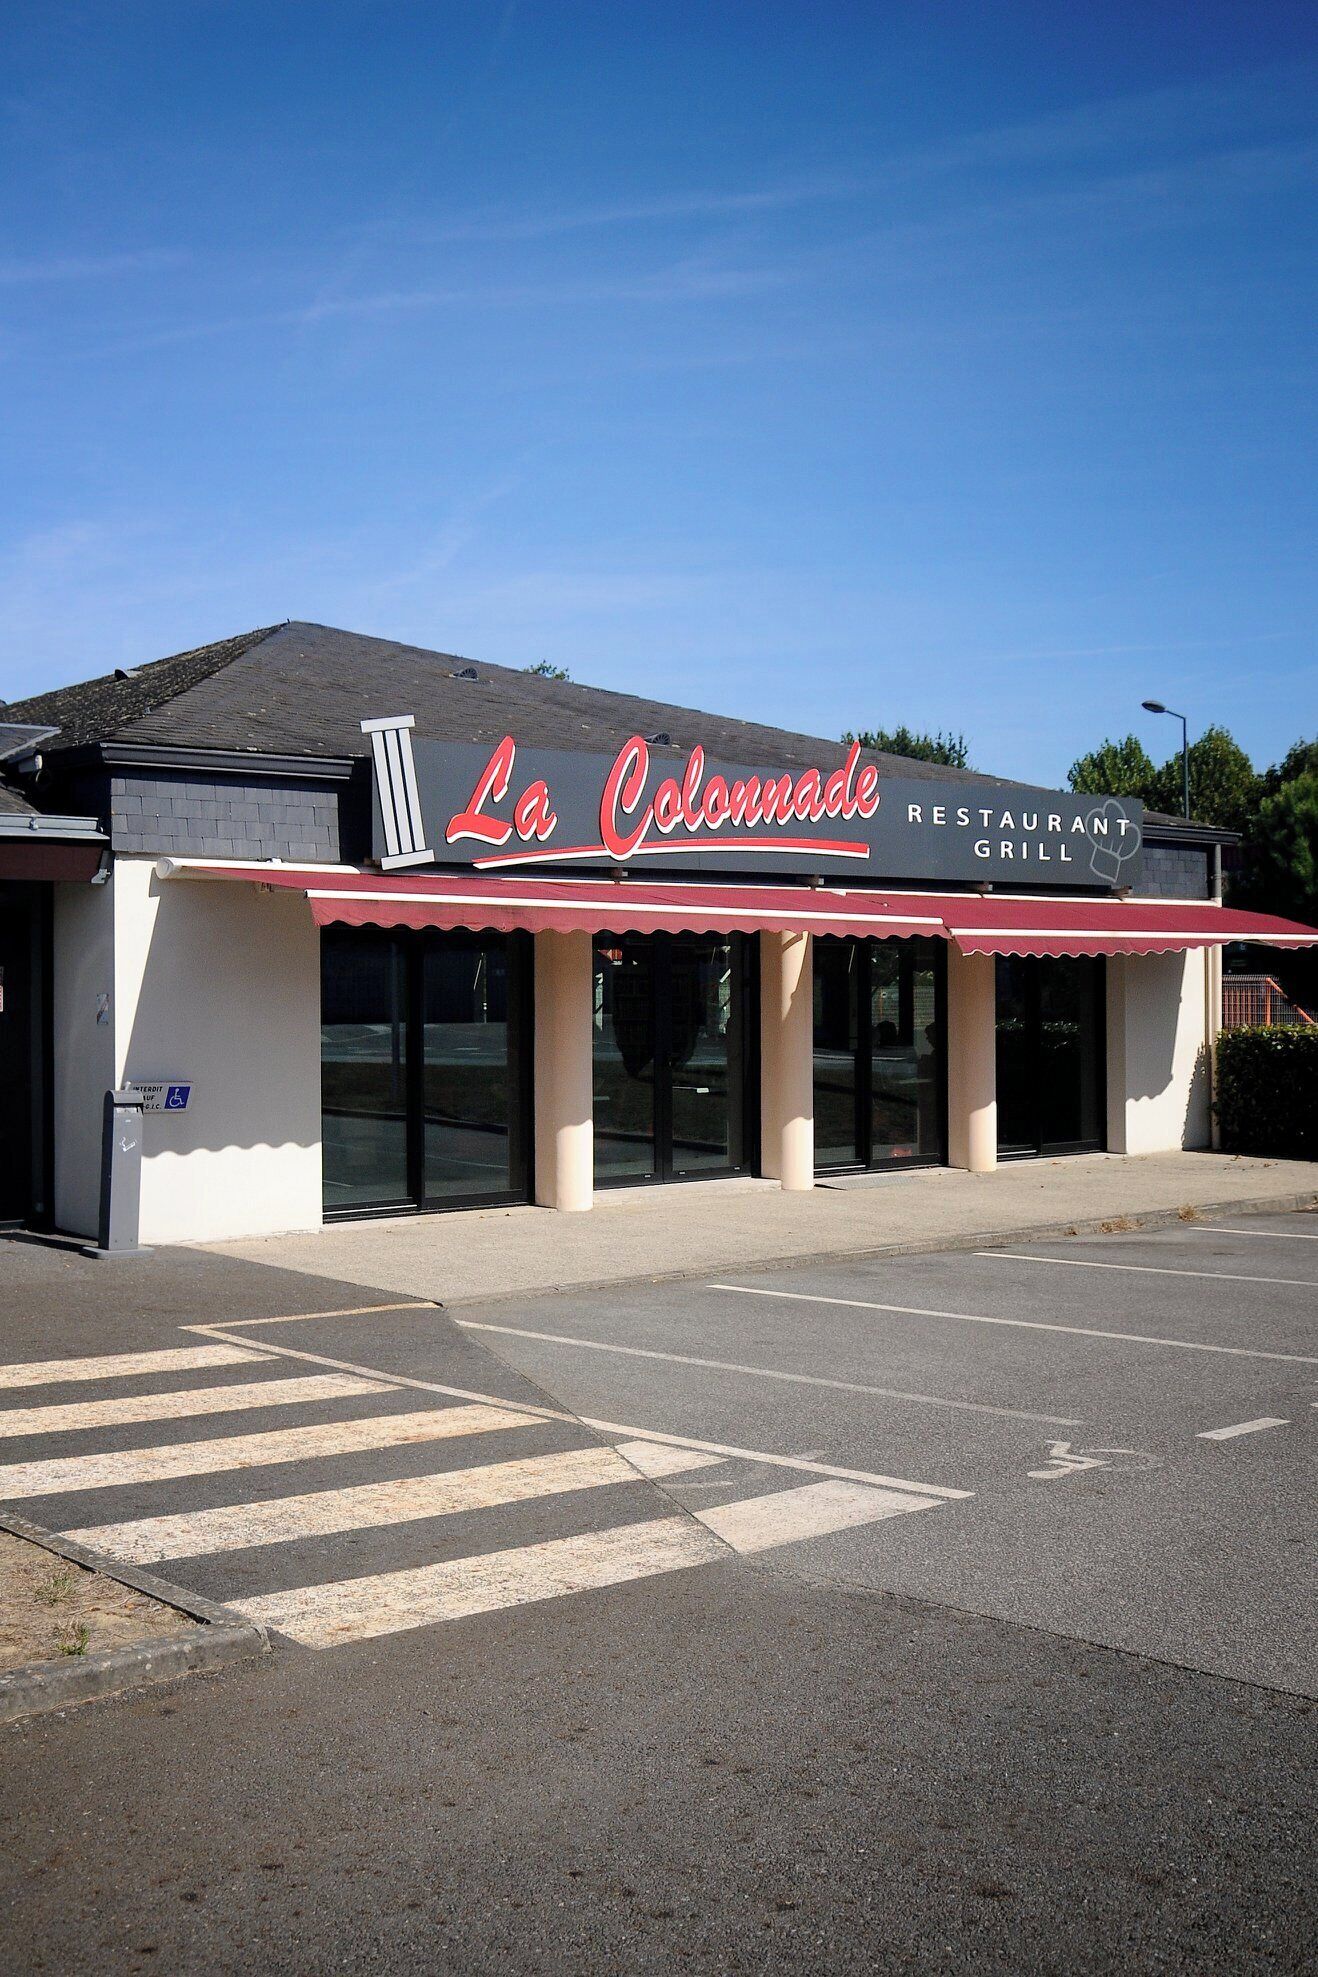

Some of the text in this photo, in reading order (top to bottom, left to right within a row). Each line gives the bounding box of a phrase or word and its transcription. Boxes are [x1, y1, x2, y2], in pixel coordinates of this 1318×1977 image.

[445, 735, 880, 861] La Colonnade
[907, 804, 1130, 836] RESTAURANT
[974, 839, 1072, 862] GRILL
